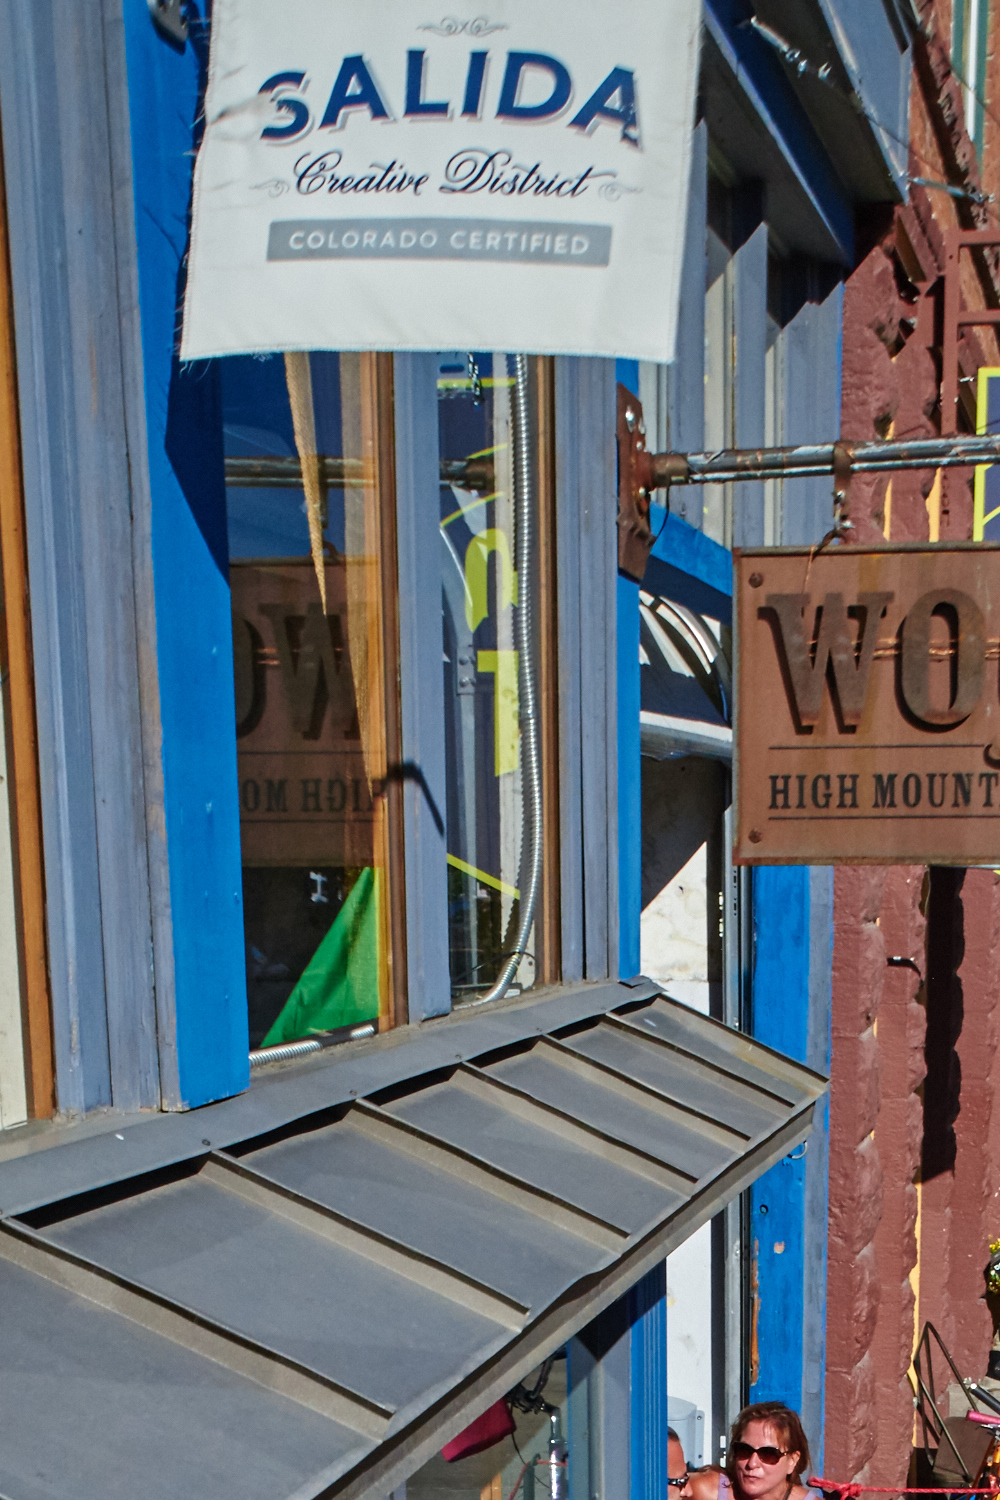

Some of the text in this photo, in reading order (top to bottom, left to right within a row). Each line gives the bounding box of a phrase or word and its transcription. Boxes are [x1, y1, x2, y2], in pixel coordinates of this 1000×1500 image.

[258, 48, 645, 152] SALIDA
[293, 148, 618, 198] Creative District
[288, 230, 590, 256] COLORADO CERTIFIED
[768, 772, 860, 811] HIGH
